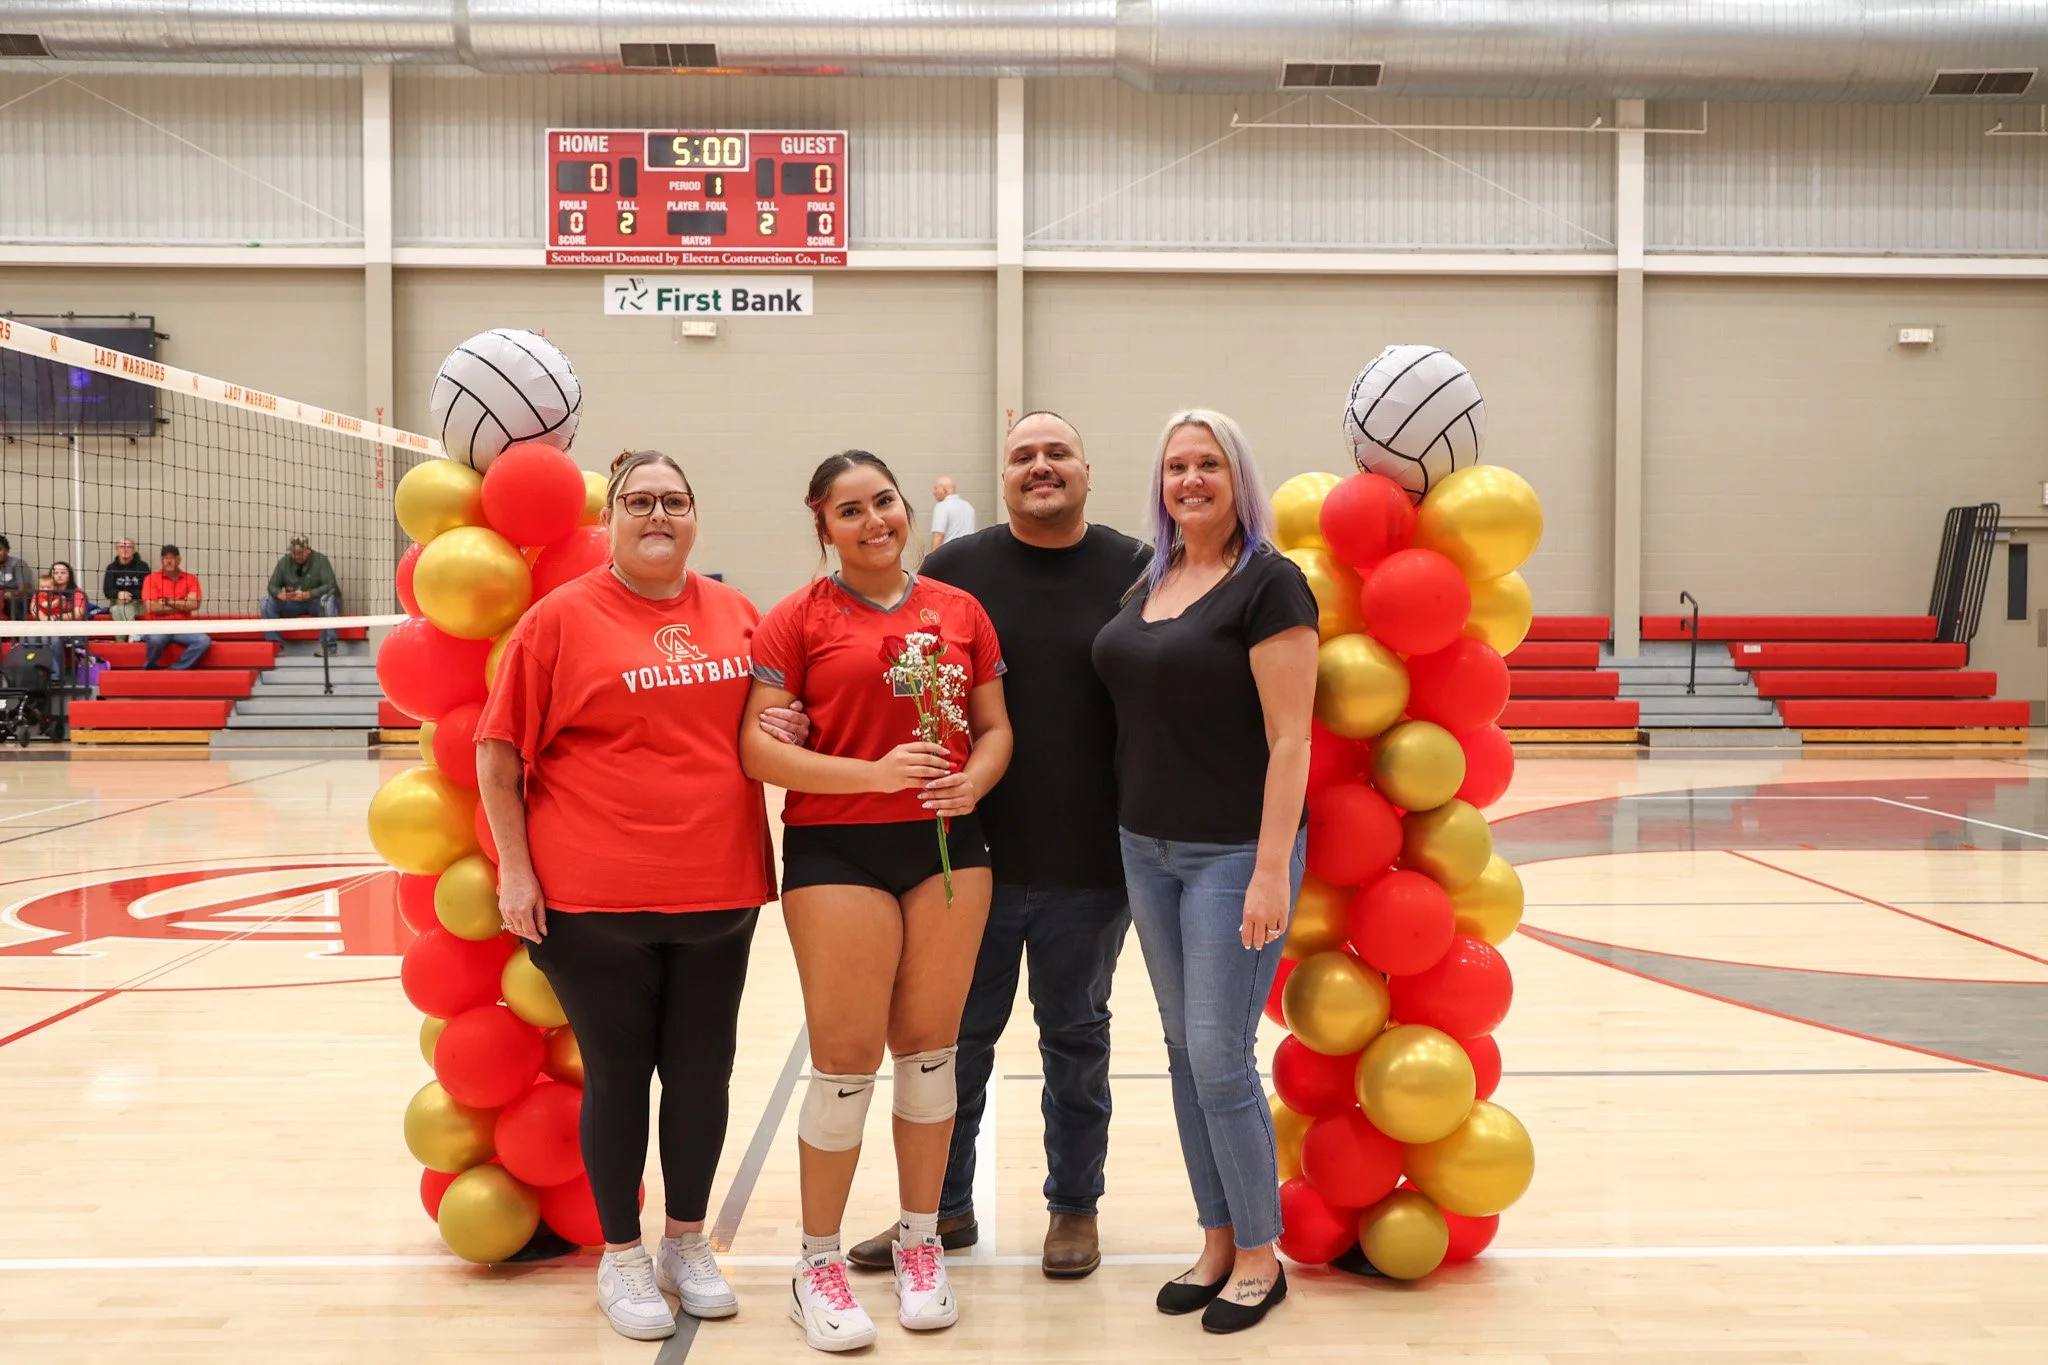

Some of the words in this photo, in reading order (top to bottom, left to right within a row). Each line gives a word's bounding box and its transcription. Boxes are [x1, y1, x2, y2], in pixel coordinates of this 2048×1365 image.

[559, 135, 609, 152] HOME
[672, 136, 741, 166] 5:00
[781, 136, 837, 154] GUEST
[590, 163, 608, 192] 0
[669, 181, 701, 191] PERIOD
[715, 176, 722, 195] 1
[815, 164, 832, 193] 0
[559, 200, 588, 211] FOULS
[616, 200, 640, 211] T.O.L.
[667, 201, 700, 211] PLAYER
[705, 201, 728, 211] FOUL
[756, 201, 779, 211] T.O.L.
[807, 201, 836, 212] FOULS
[570, 211, 584, 233] 0
[620, 212, 634, 234] 2
[760, 213, 774, 235] 2
[818, 213, 832, 235] 0
[557, 235, 587, 246] SCORE
[681, 236, 711, 246] MATCH
[806, 236, 836, 247] SCORE
[551, 252, 613, 263] Scoreboard
[616, 252, 661, 263] Donated
[666, 252, 679, 265] by
[682, 253, 720, 264] Electra
[721, 253, 793, 264] Construction
[795, 253, 817, 265] Co.,
[820, 253, 841, 264] Inc.
[657, 288, 722, 311] First
[731, 288, 802, 312] Bank
[94, 347, 118, 369] LADY
[122, 355, 165, 382] WARRIORS
[224, 384, 242, 401] LADY
[245, 389, 276, 411] WARRIORS
[814, 1257, 827, 1267] NIKE
